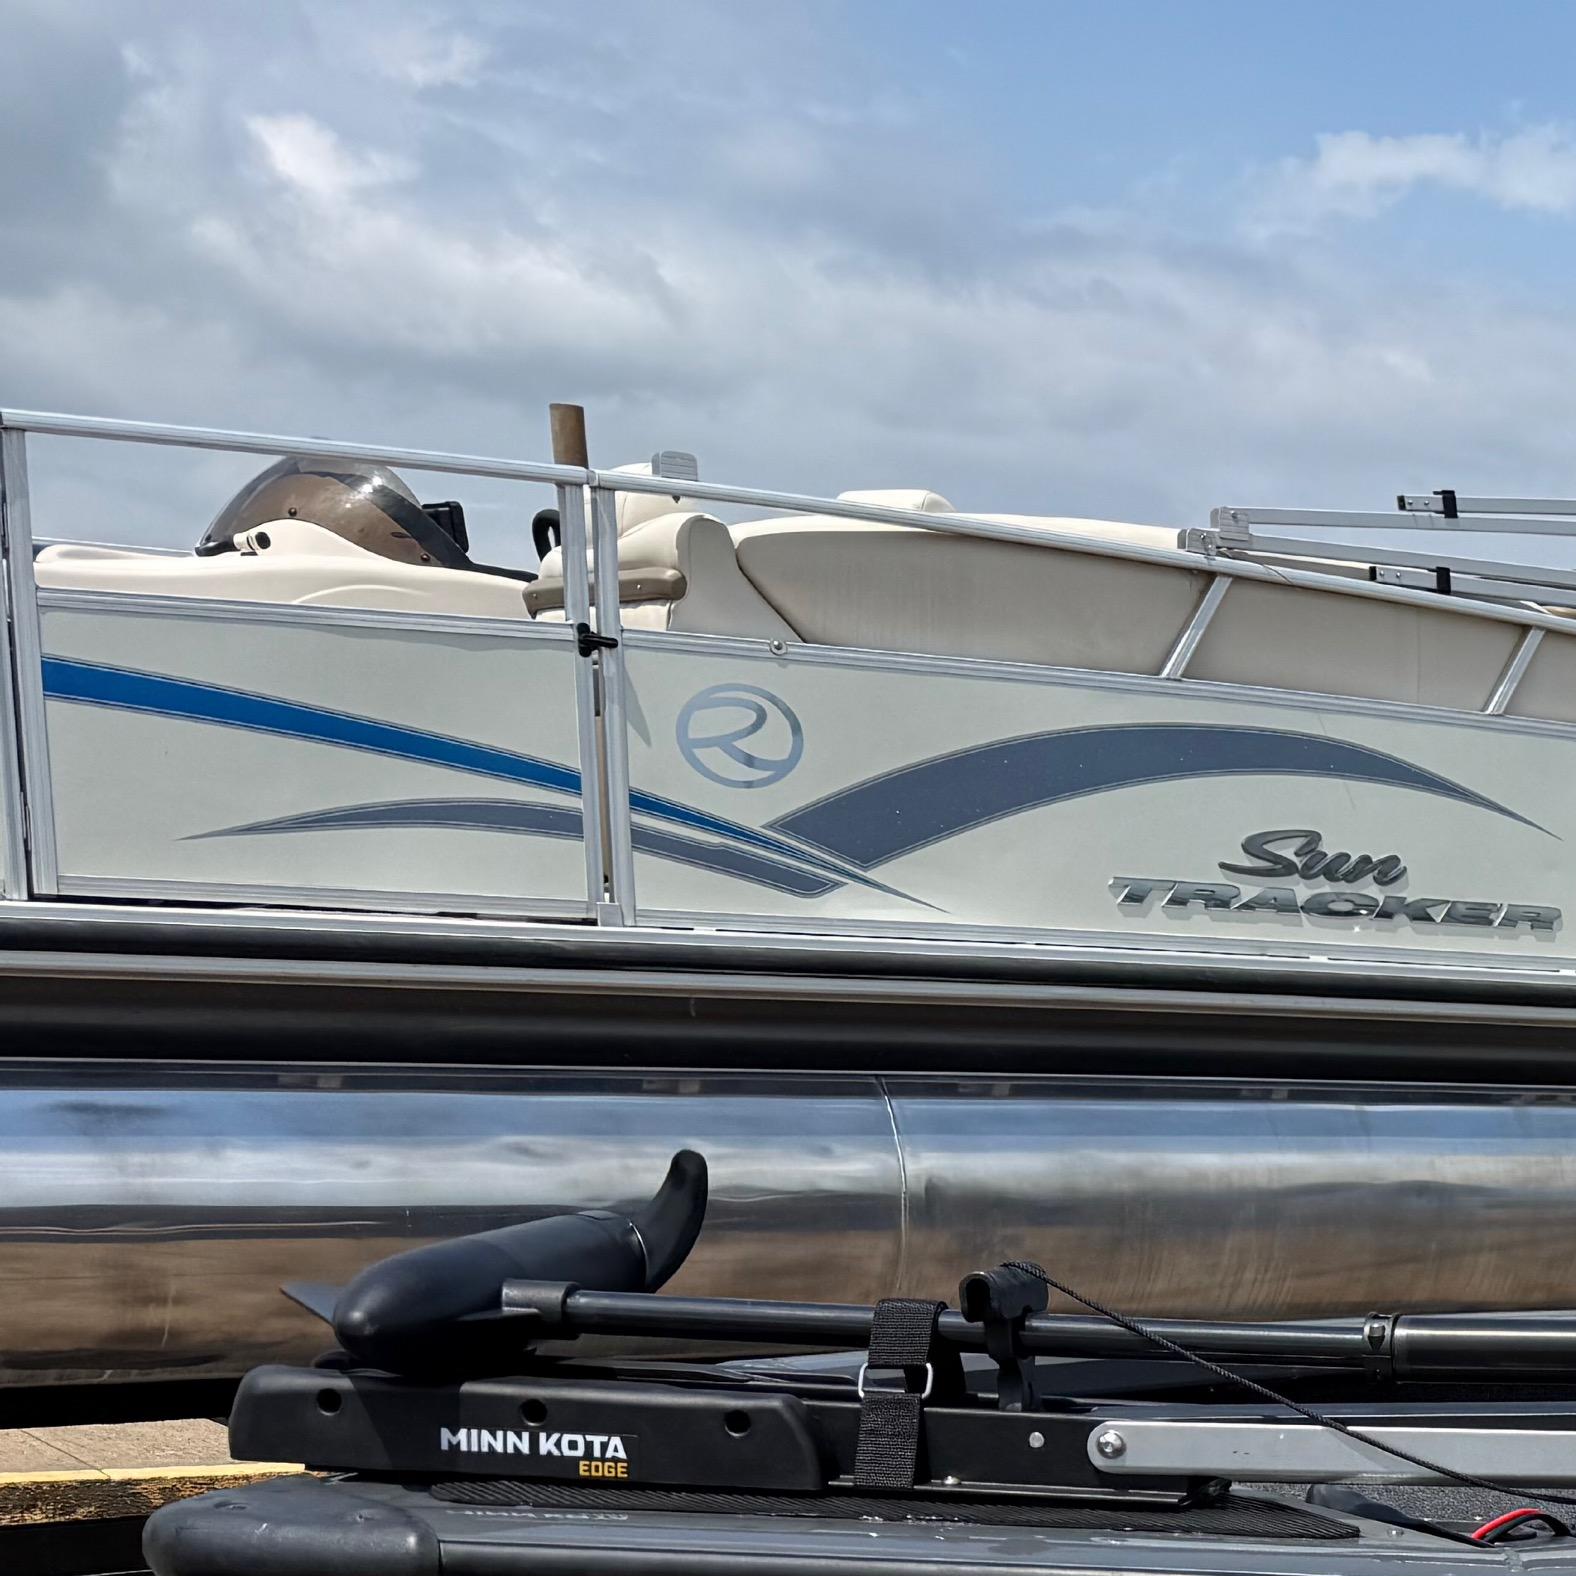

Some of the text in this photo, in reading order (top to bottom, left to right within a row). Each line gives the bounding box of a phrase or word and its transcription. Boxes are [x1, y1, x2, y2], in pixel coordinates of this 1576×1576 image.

[1218, 829, 1407, 884] Sun
[1107, 876, 1564, 932] TRACKER
[440, 1427, 628, 1459] MINN KOTA
[579, 1460, 629, 1478] EDGE
